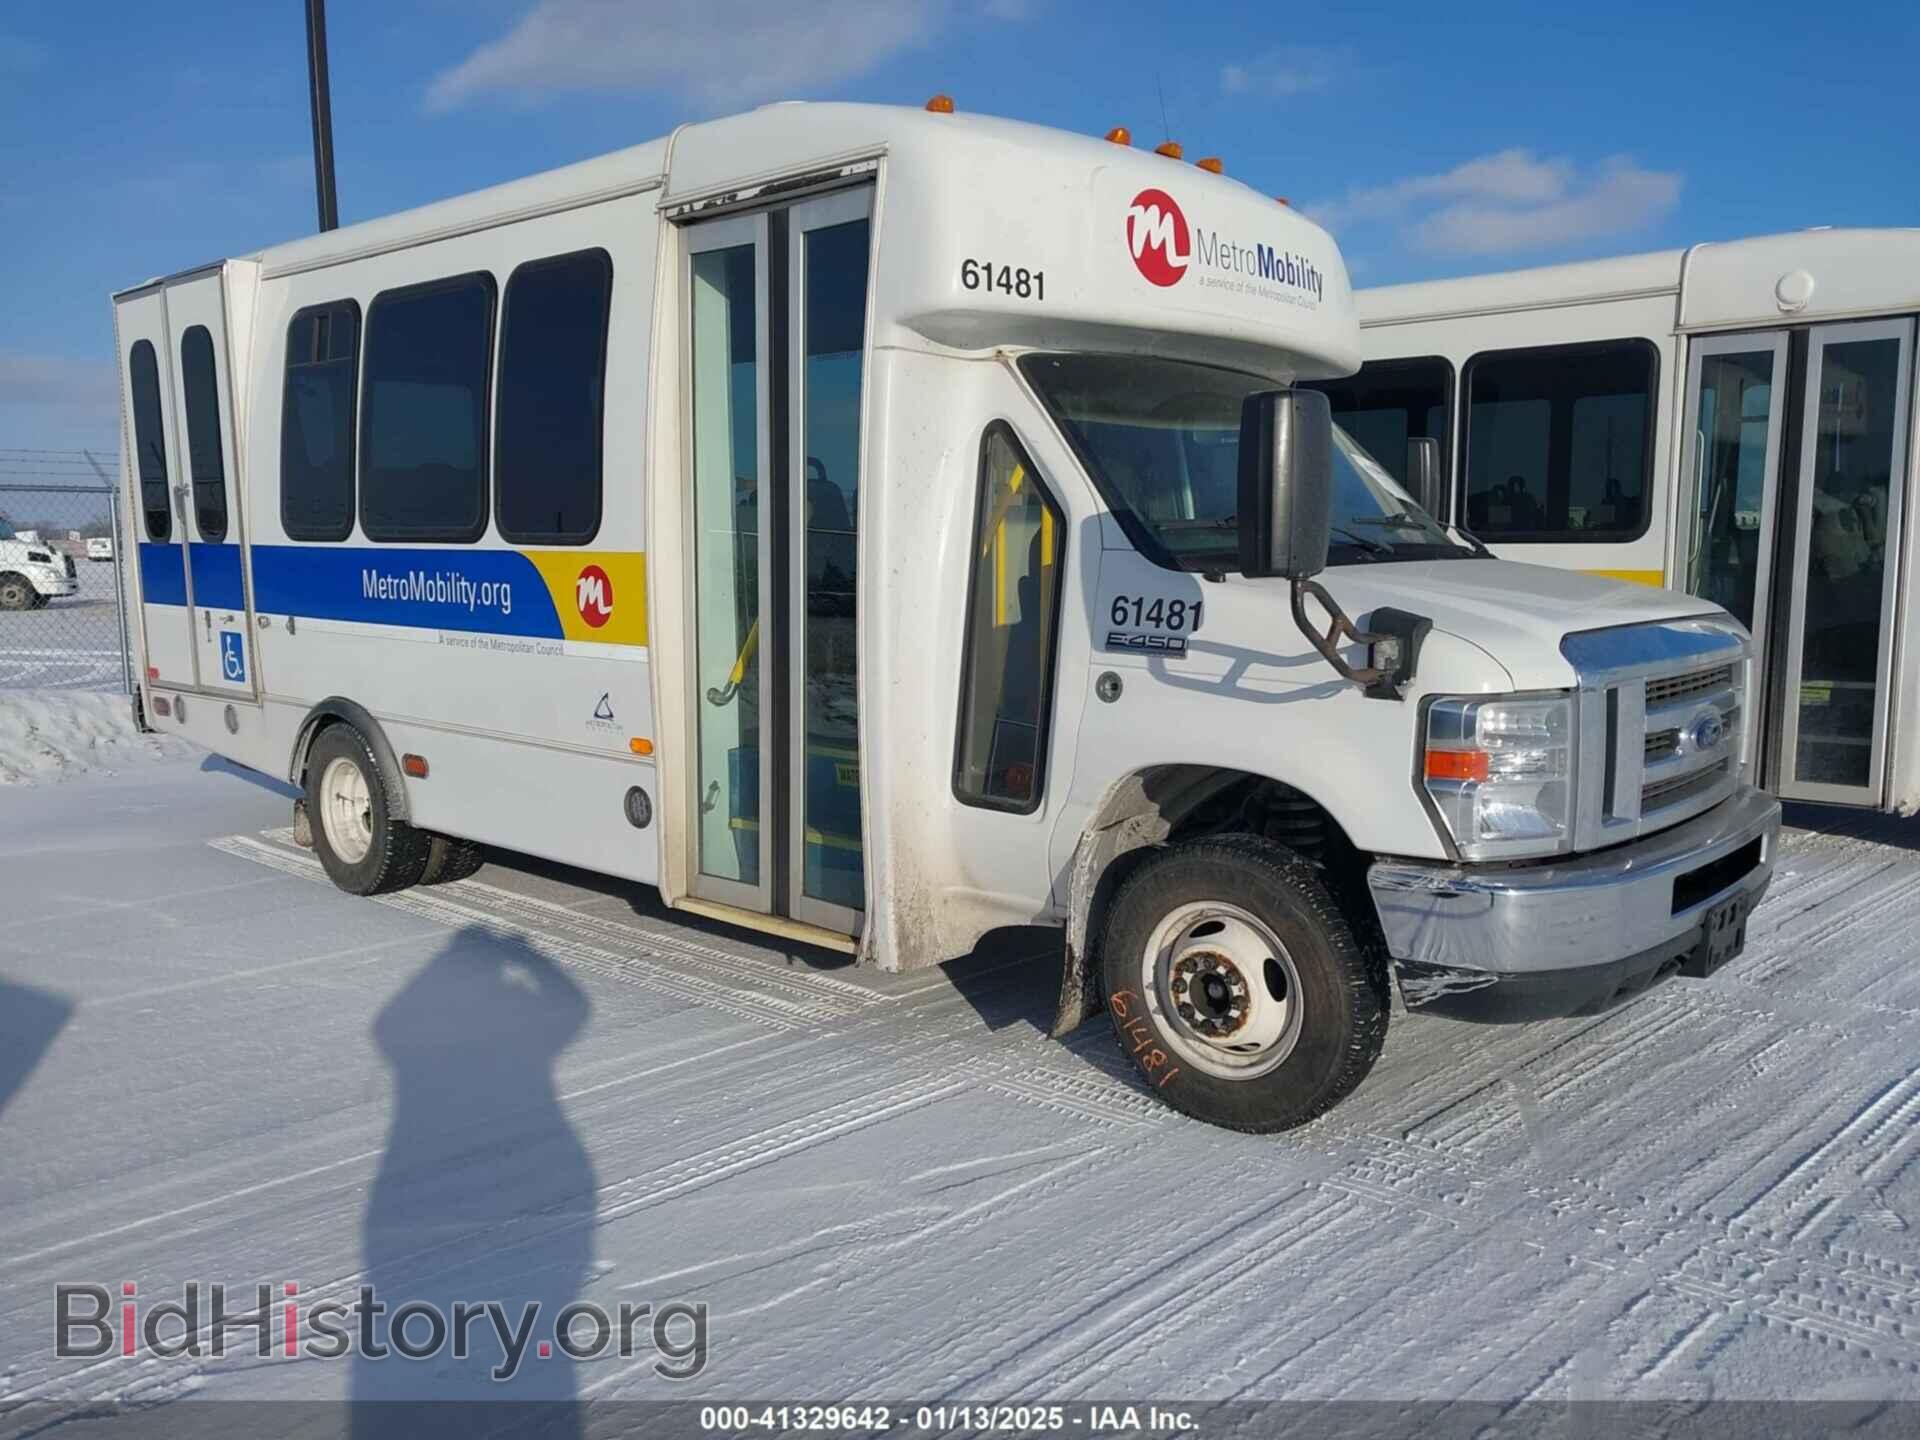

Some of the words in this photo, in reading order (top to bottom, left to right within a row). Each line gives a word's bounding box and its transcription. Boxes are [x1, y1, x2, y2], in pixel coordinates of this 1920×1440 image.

[961, 258, 1044, 300] 61481
[1197, 228, 1323, 302] MetroMobility
[362, 569, 511, 614] MetroMobility.org
[1111, 595, 1203, 632] 61481
[490, 639, 535, 655] Metropolitan
[536, 642, 564, 656] Council
